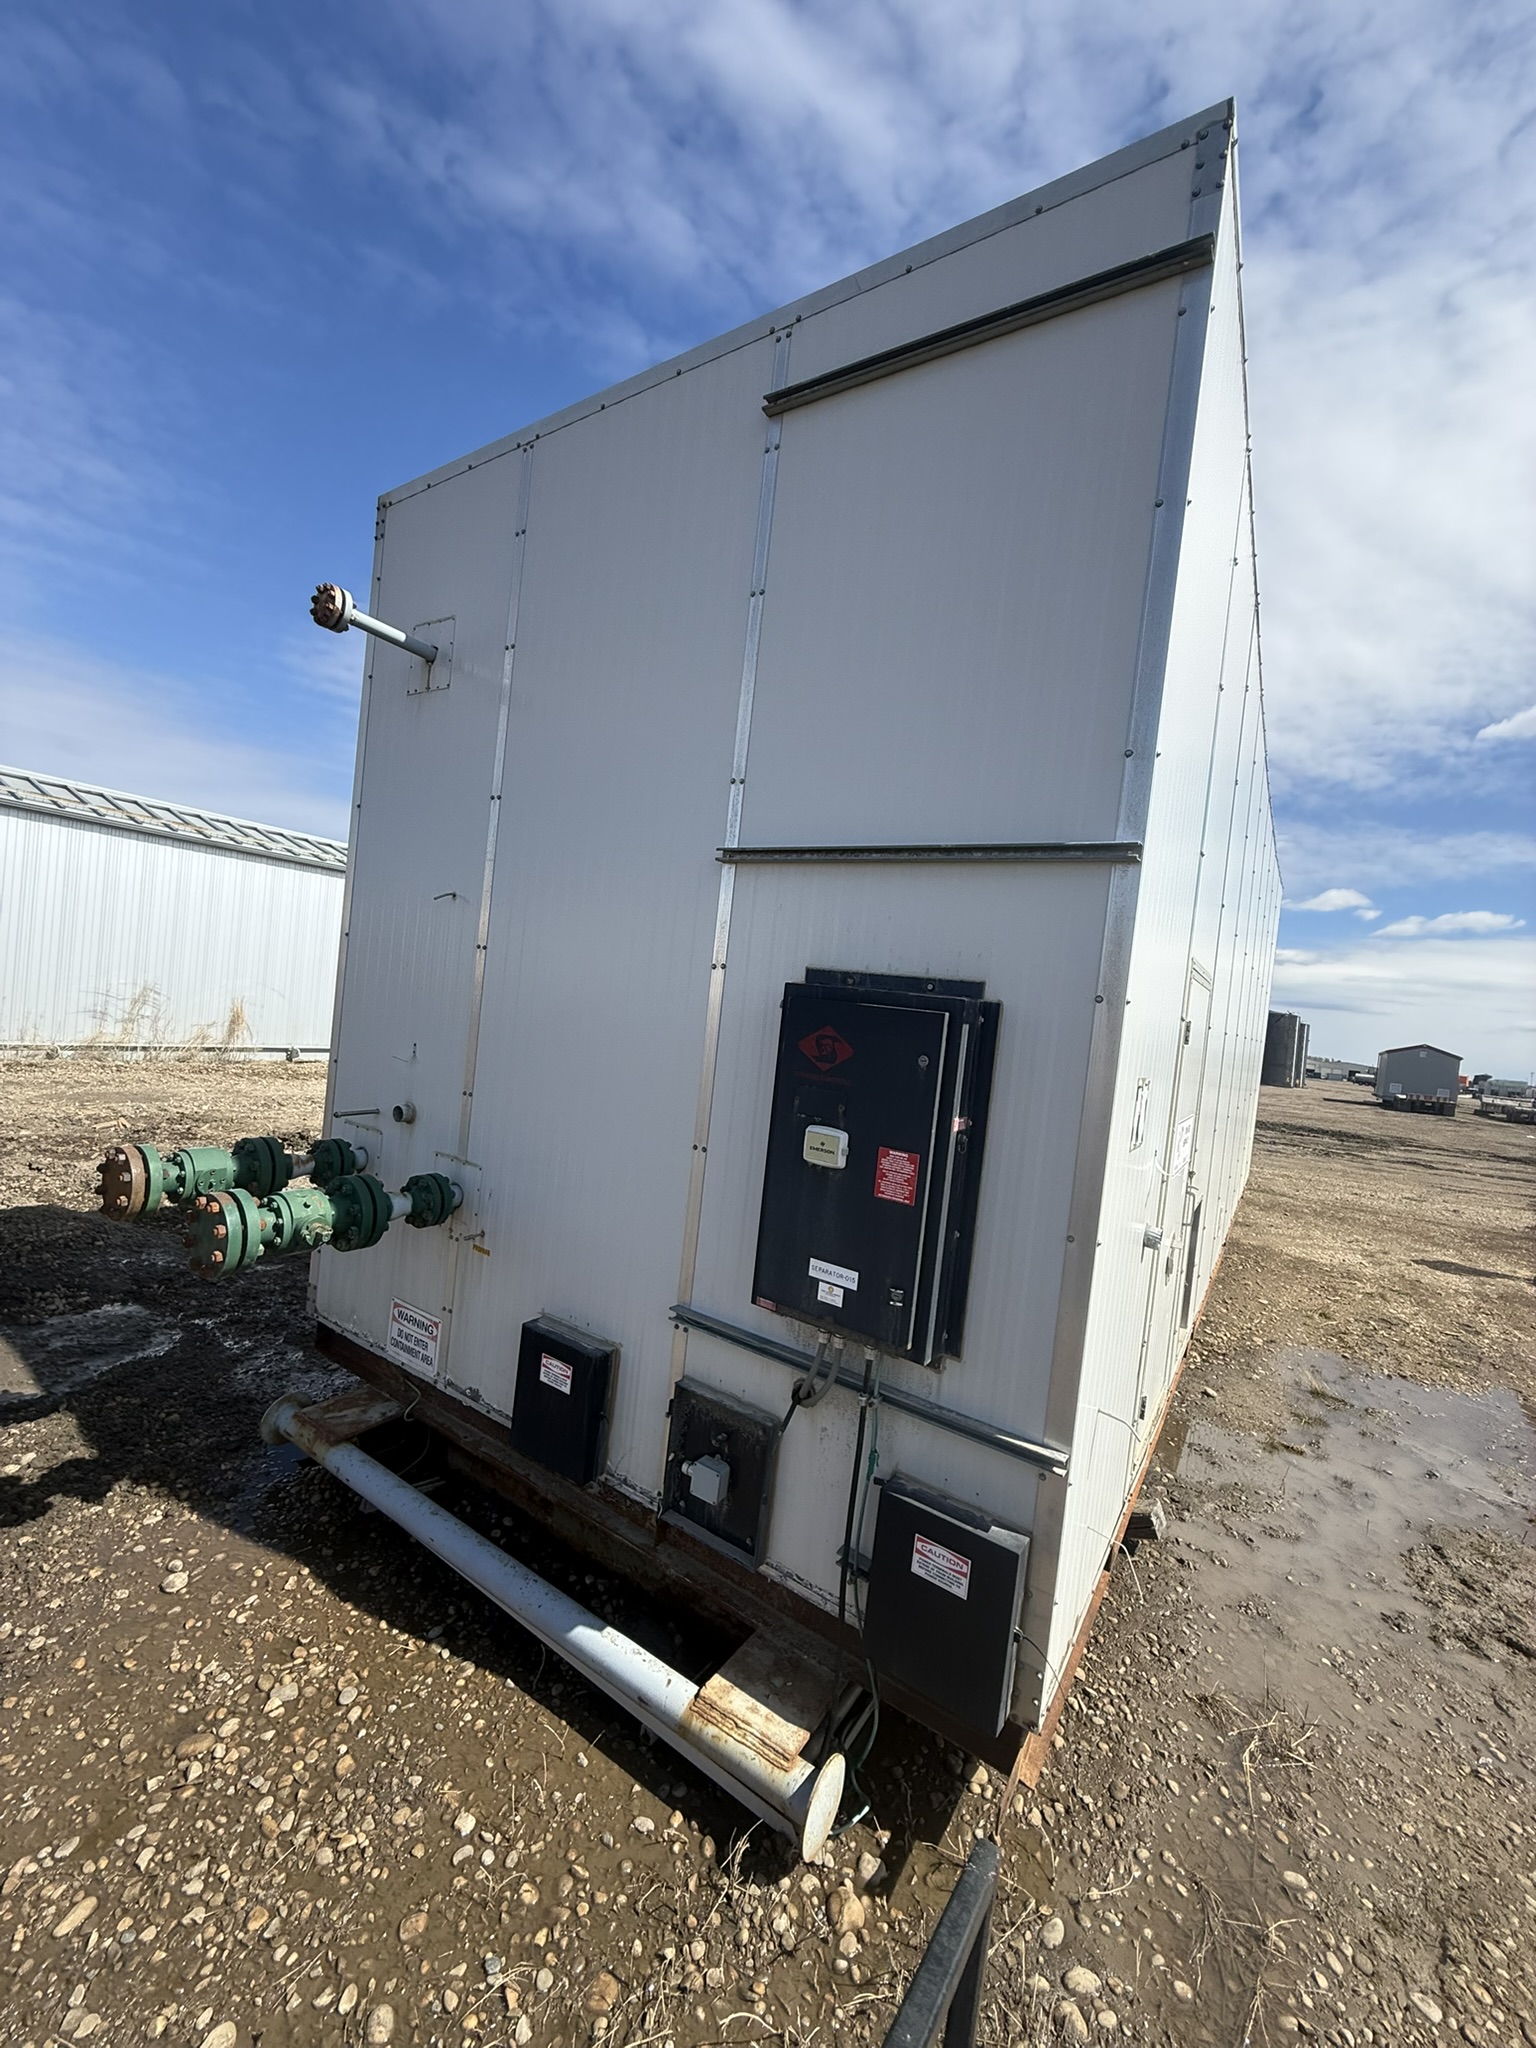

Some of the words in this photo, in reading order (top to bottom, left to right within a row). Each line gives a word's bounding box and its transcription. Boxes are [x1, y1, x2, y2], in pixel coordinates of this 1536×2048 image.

[810, 1146, 835, 1155] EMERSON
[811, 1264, 856, 1284] SEPARATOR-015
[397, 1308, 434, 1335] WARNING
[390, 1336, 421, 1360] CONTAINMENT
[421, 1352, 434, 1367] AREA
[397, 1328, 404, 1339] DO
[405, 1332, 413, 1342] NOT
[413, 1336, 428, 1352] ENTER
[545, 1360, 568, 1373] CAUTION
[920, 1544, 963, 1570] CAUTION
